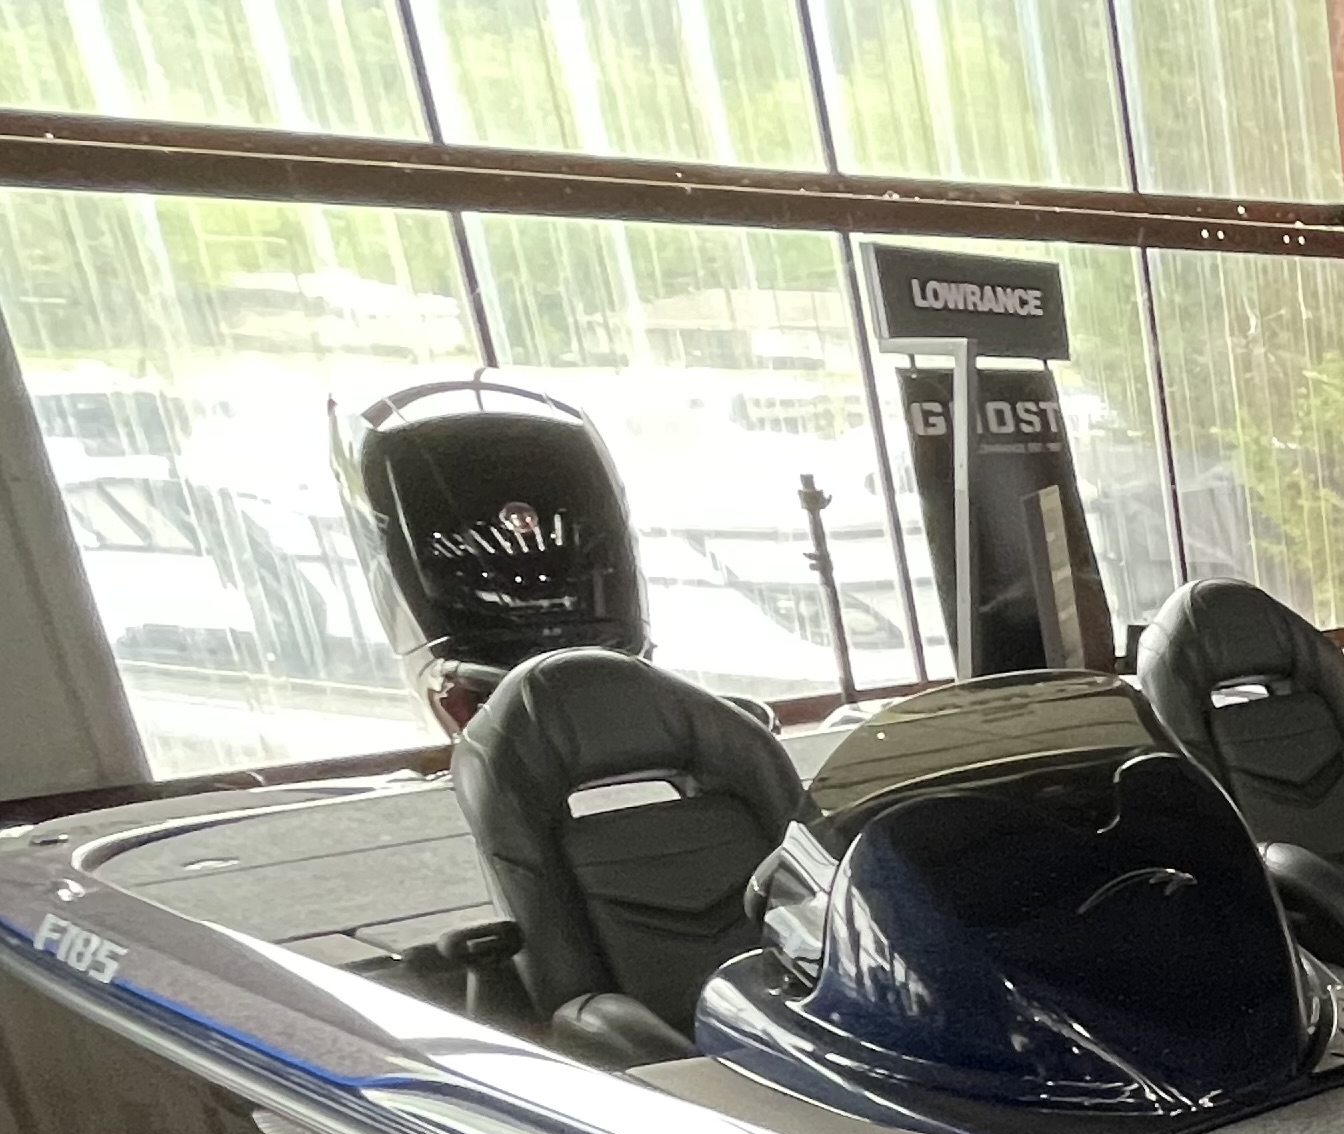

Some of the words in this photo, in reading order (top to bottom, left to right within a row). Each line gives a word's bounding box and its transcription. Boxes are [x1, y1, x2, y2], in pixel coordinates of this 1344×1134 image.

[911, 277, 1044, 318] LOWRANCE
[910, 400, 1061, 438] GOST
[33, 913, 129, 984] F185
